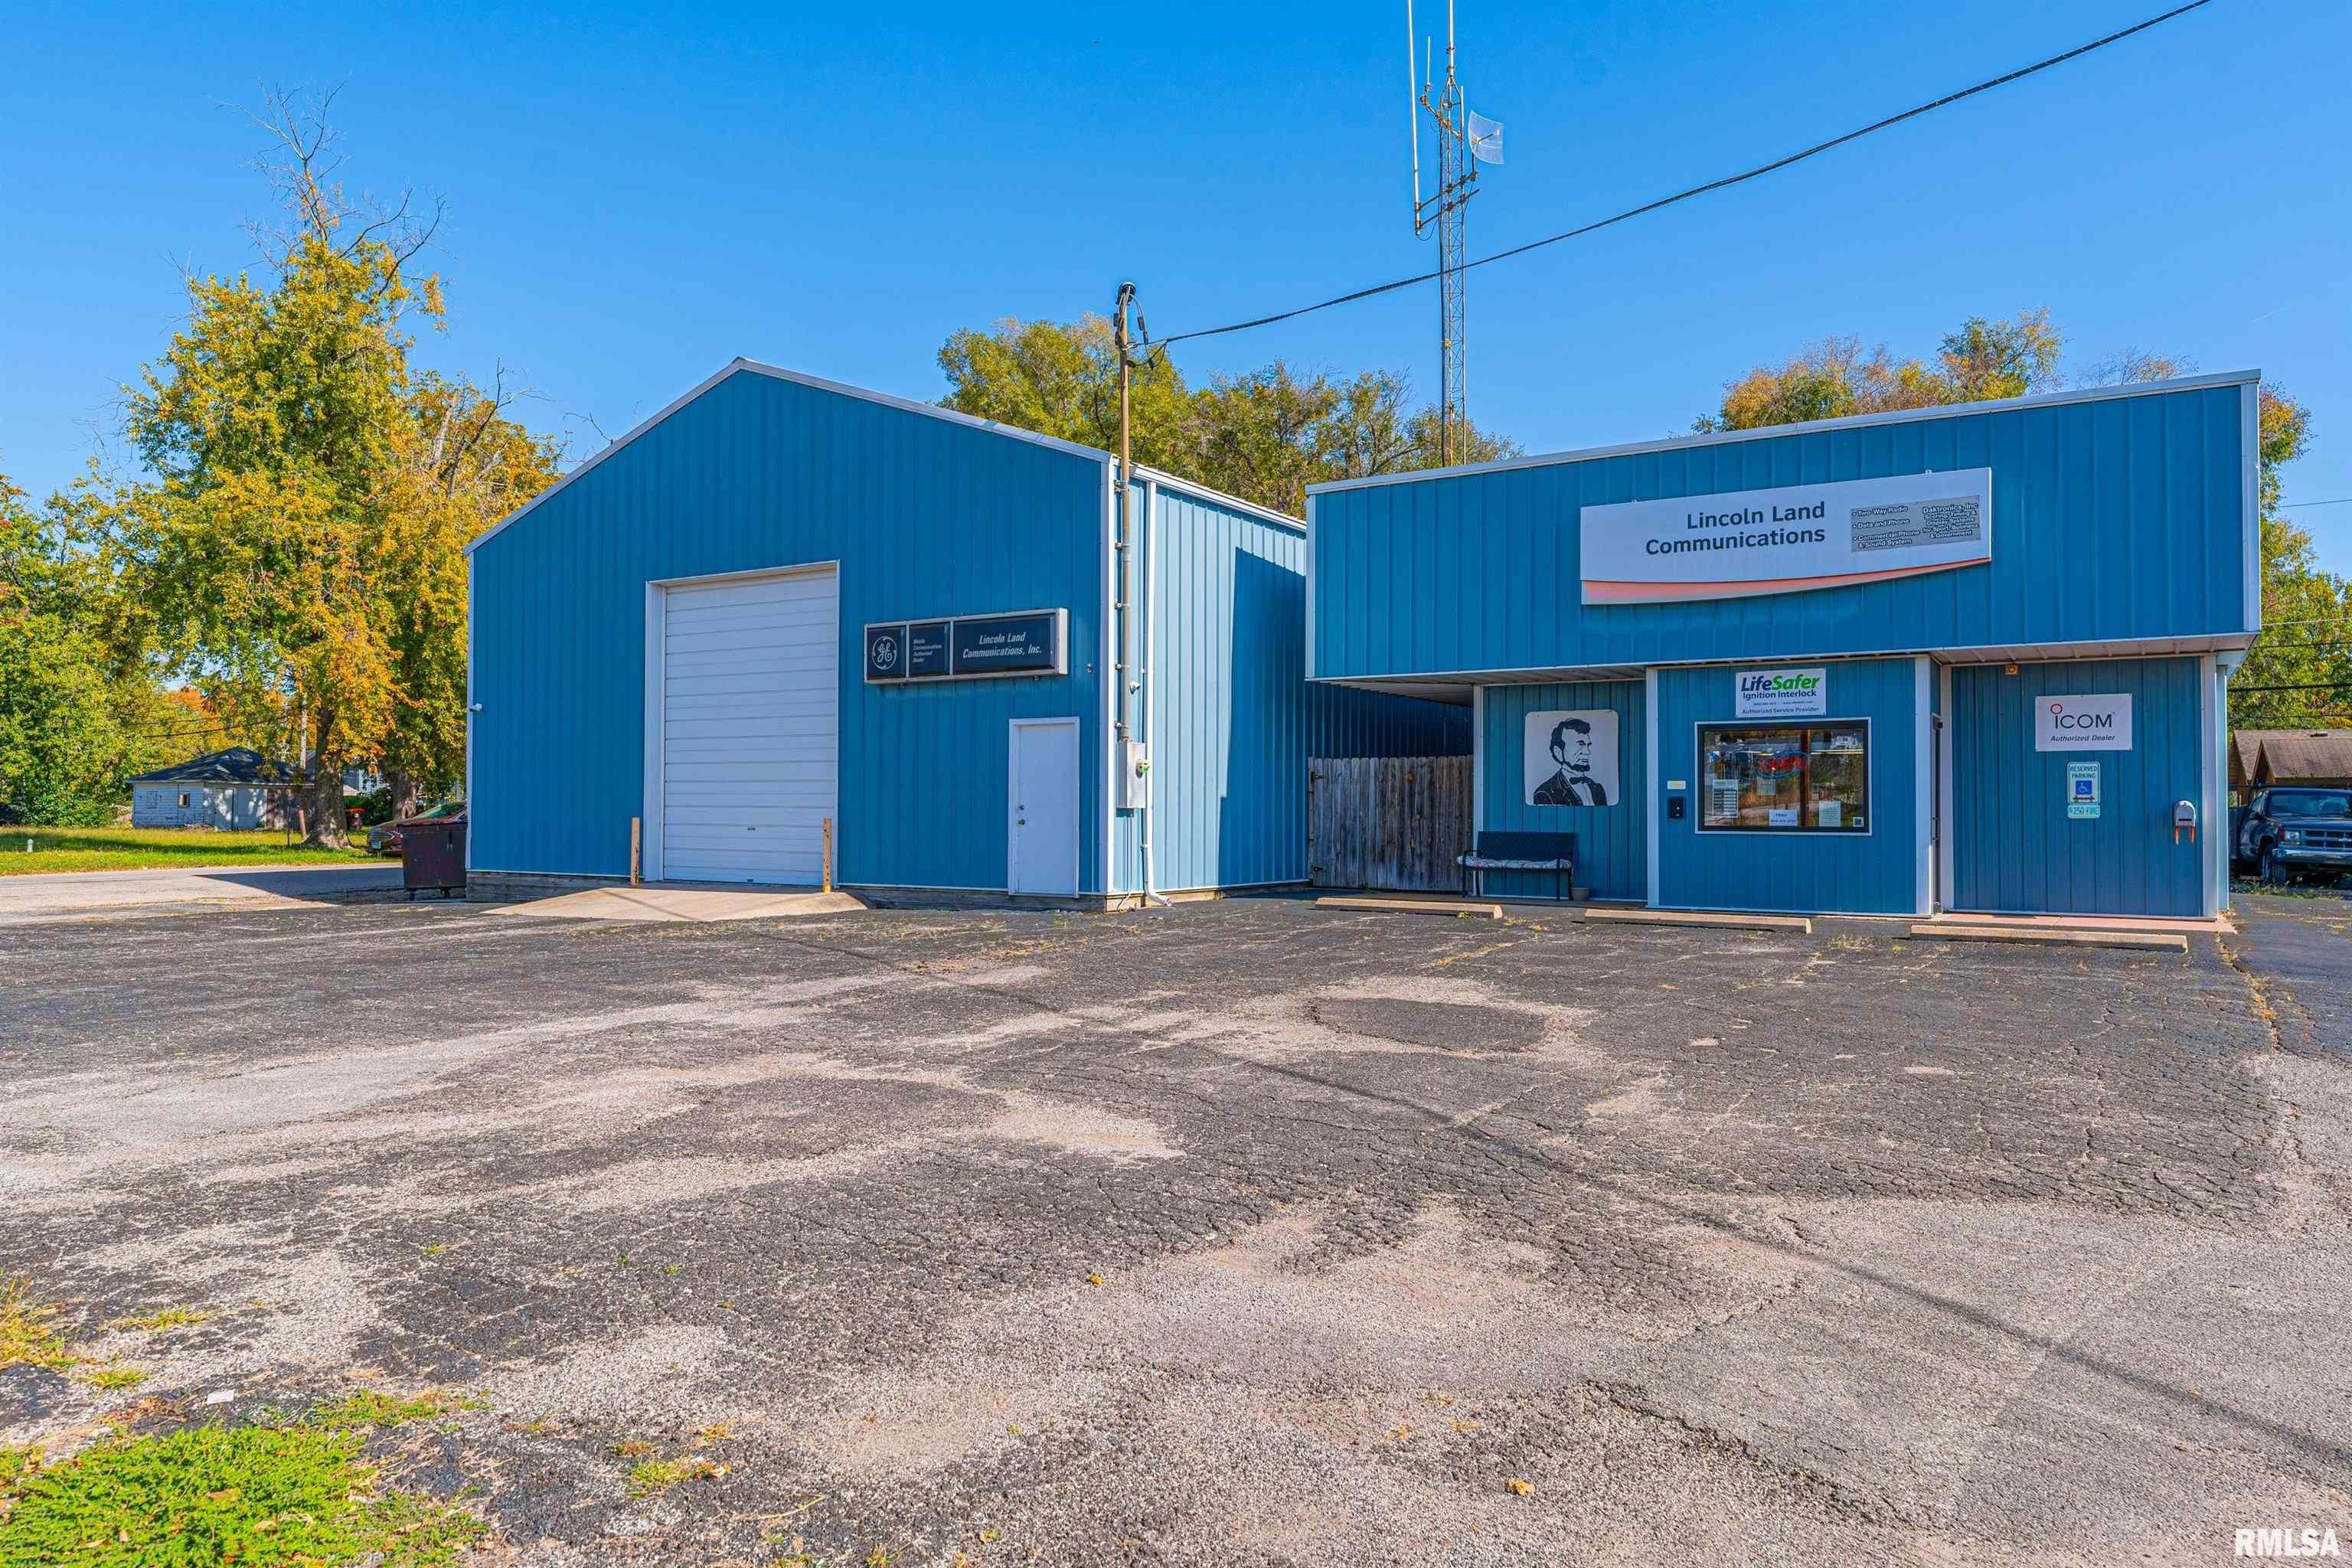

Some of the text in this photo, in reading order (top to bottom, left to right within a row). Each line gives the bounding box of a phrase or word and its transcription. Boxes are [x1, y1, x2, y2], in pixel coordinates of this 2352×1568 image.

[1687, 501, 1825, 529] Lincoln Land
[1858, 532, 1897, 541] Commercial
[1936, 530, 1972, 538] Government
[1646, 528, 1825, 555] Communications
[1887, 537, 1912, 547] System
[979, 632, 1026, 645] Lincoln Land
[962, 645, 1042, 659] Communications, Inc.
[1741, 674, 1821, 692] LifeSafer
[1743, 689, 1817, 701] Ignition Interlock
